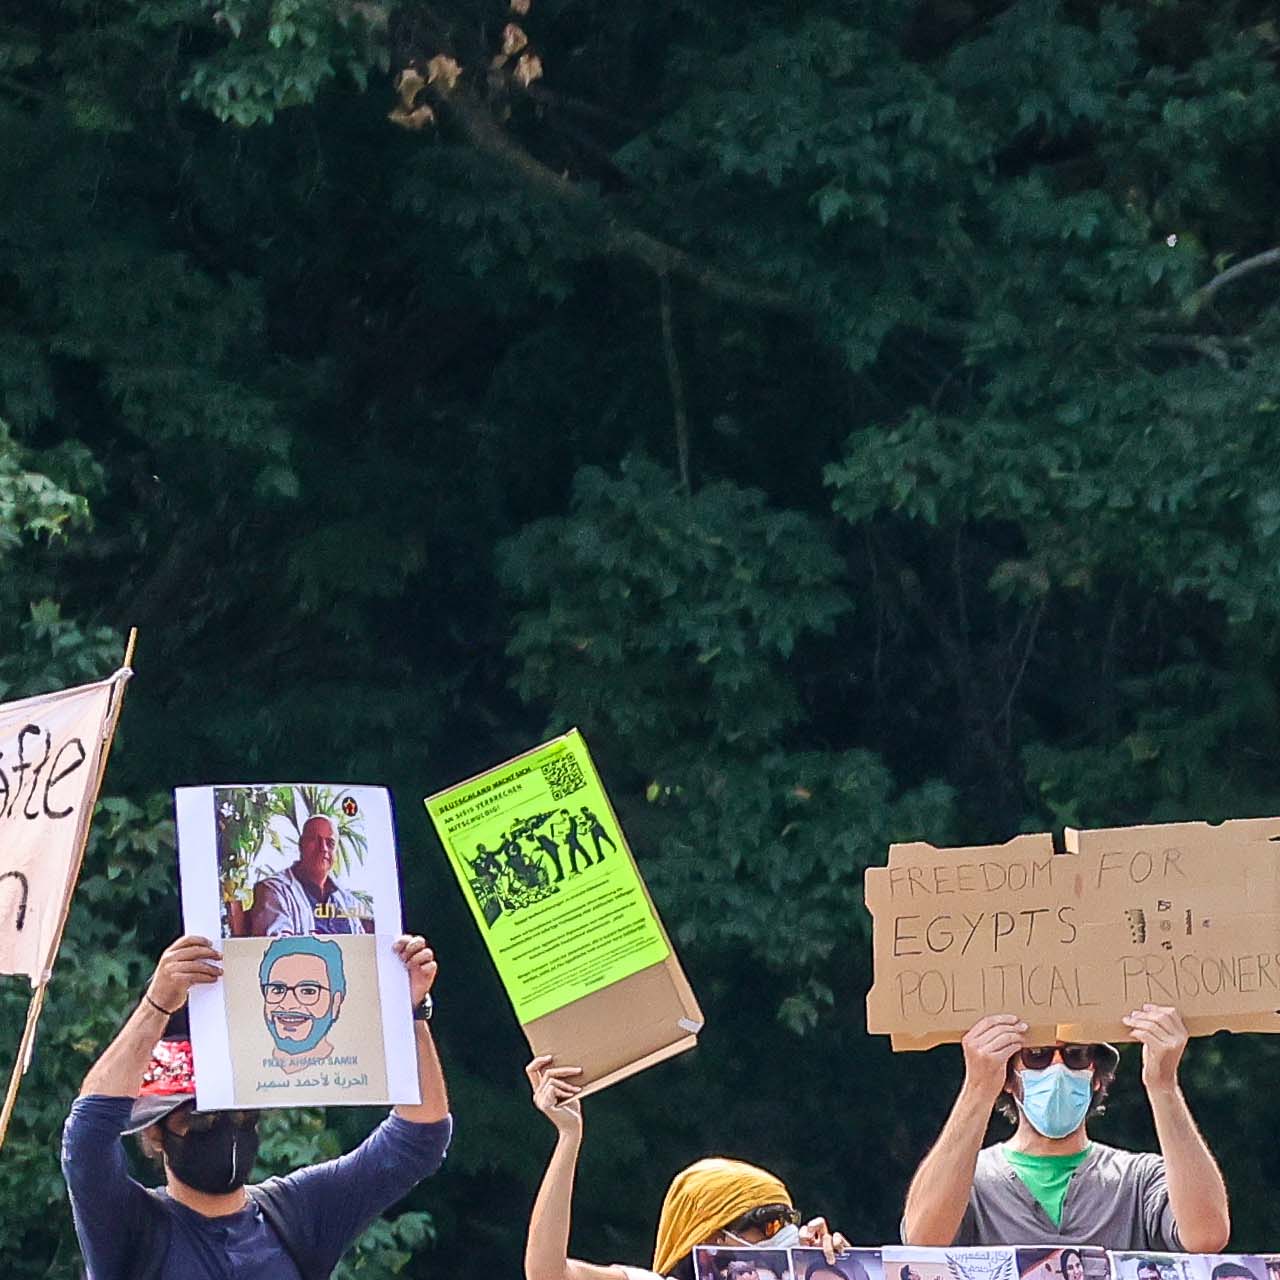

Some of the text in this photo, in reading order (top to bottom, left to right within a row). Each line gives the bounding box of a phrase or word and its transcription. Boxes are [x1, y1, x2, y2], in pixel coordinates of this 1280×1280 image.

[889, 847, 1185, 898] FREEDOM FOR
[896, 964, 1099, 1020] POLITICAL
